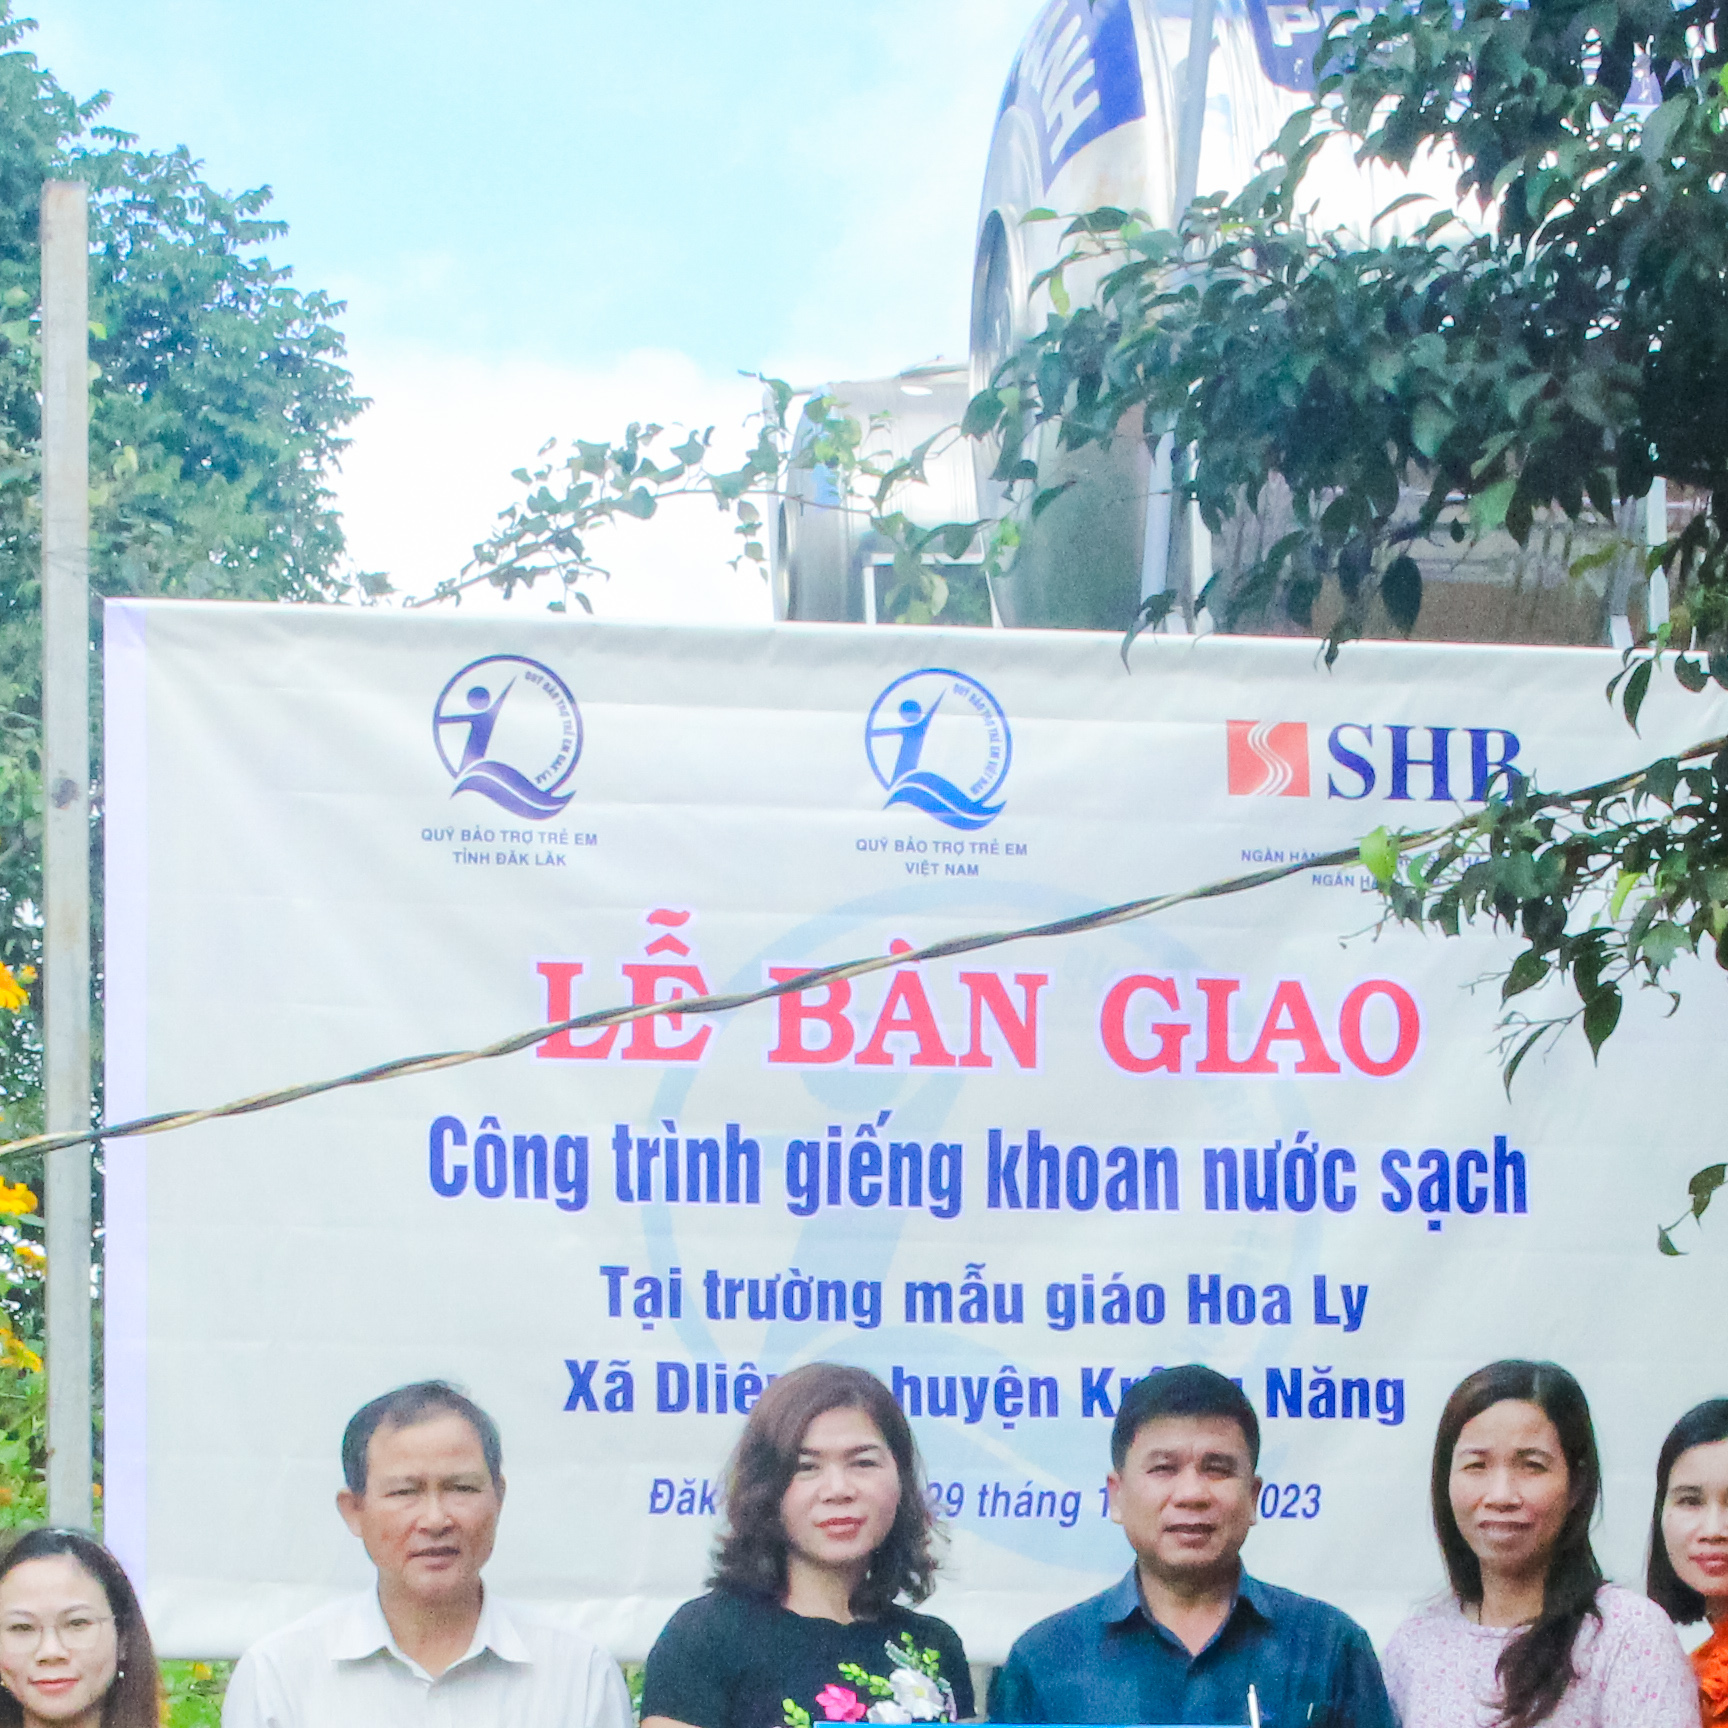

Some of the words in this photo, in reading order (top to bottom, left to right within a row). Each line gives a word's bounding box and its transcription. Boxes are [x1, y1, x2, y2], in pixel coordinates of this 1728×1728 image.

[1328, 723, 1521, 802] SHB
[421, 826, 455, 841] QUỸ
[461, 825, 495, 842] BẢO
[500, 829, 533, 845] TRỢ
[538, 828, 569, 845] TRẺ
[574, 833, 598, 845] EM
[453, 848, 490, 864] TỈNH
[856, 837, 888, 852] QUỸ
[894, 836, 928, 853] BẢO
[933, 840, 965, 856] TRỢ
[969, 839, 1000, 855] TRẺ
[1005, 843, 1028, 855] EM
[905, 860, 939, 876] VIỆT
[945, 864, 979, 876] NAM
[535, 908, 714, 1063] LỄ
[767, 938, 1050, 1070] BÀN
[1099, 973, 1422, 1078] GIAO
[429, 1115, 589, 1212] Công
[612, 1119, 761, 1204] trình
[786, 1110, 963, 1219] giếng
[987, 1128, 1180, 1211] khoan
[1203, 1131, 1356, 1212] nước
[1380, 1135, 1529, 1232] sạch
[599, 1265, 683, 1330] Tại
[703, 1267, 882, 1330] trường
[904, 1262, 1023, 1324] mẫu
[1046, 1272, 1165, 1332] giáo
[1187, 1273, 1292, 1325] Hoa
[1313, 1273, 1369, 1333] Ly
[563, 1359, 634, 1413] Xã
[892, 1365, 1059, 1430] huyện
[1265, 1365, 1406, 1426] Năng
[649, 1478, 718, 1516] Đăk
[977, 1480, 1082, 1527] tháng
